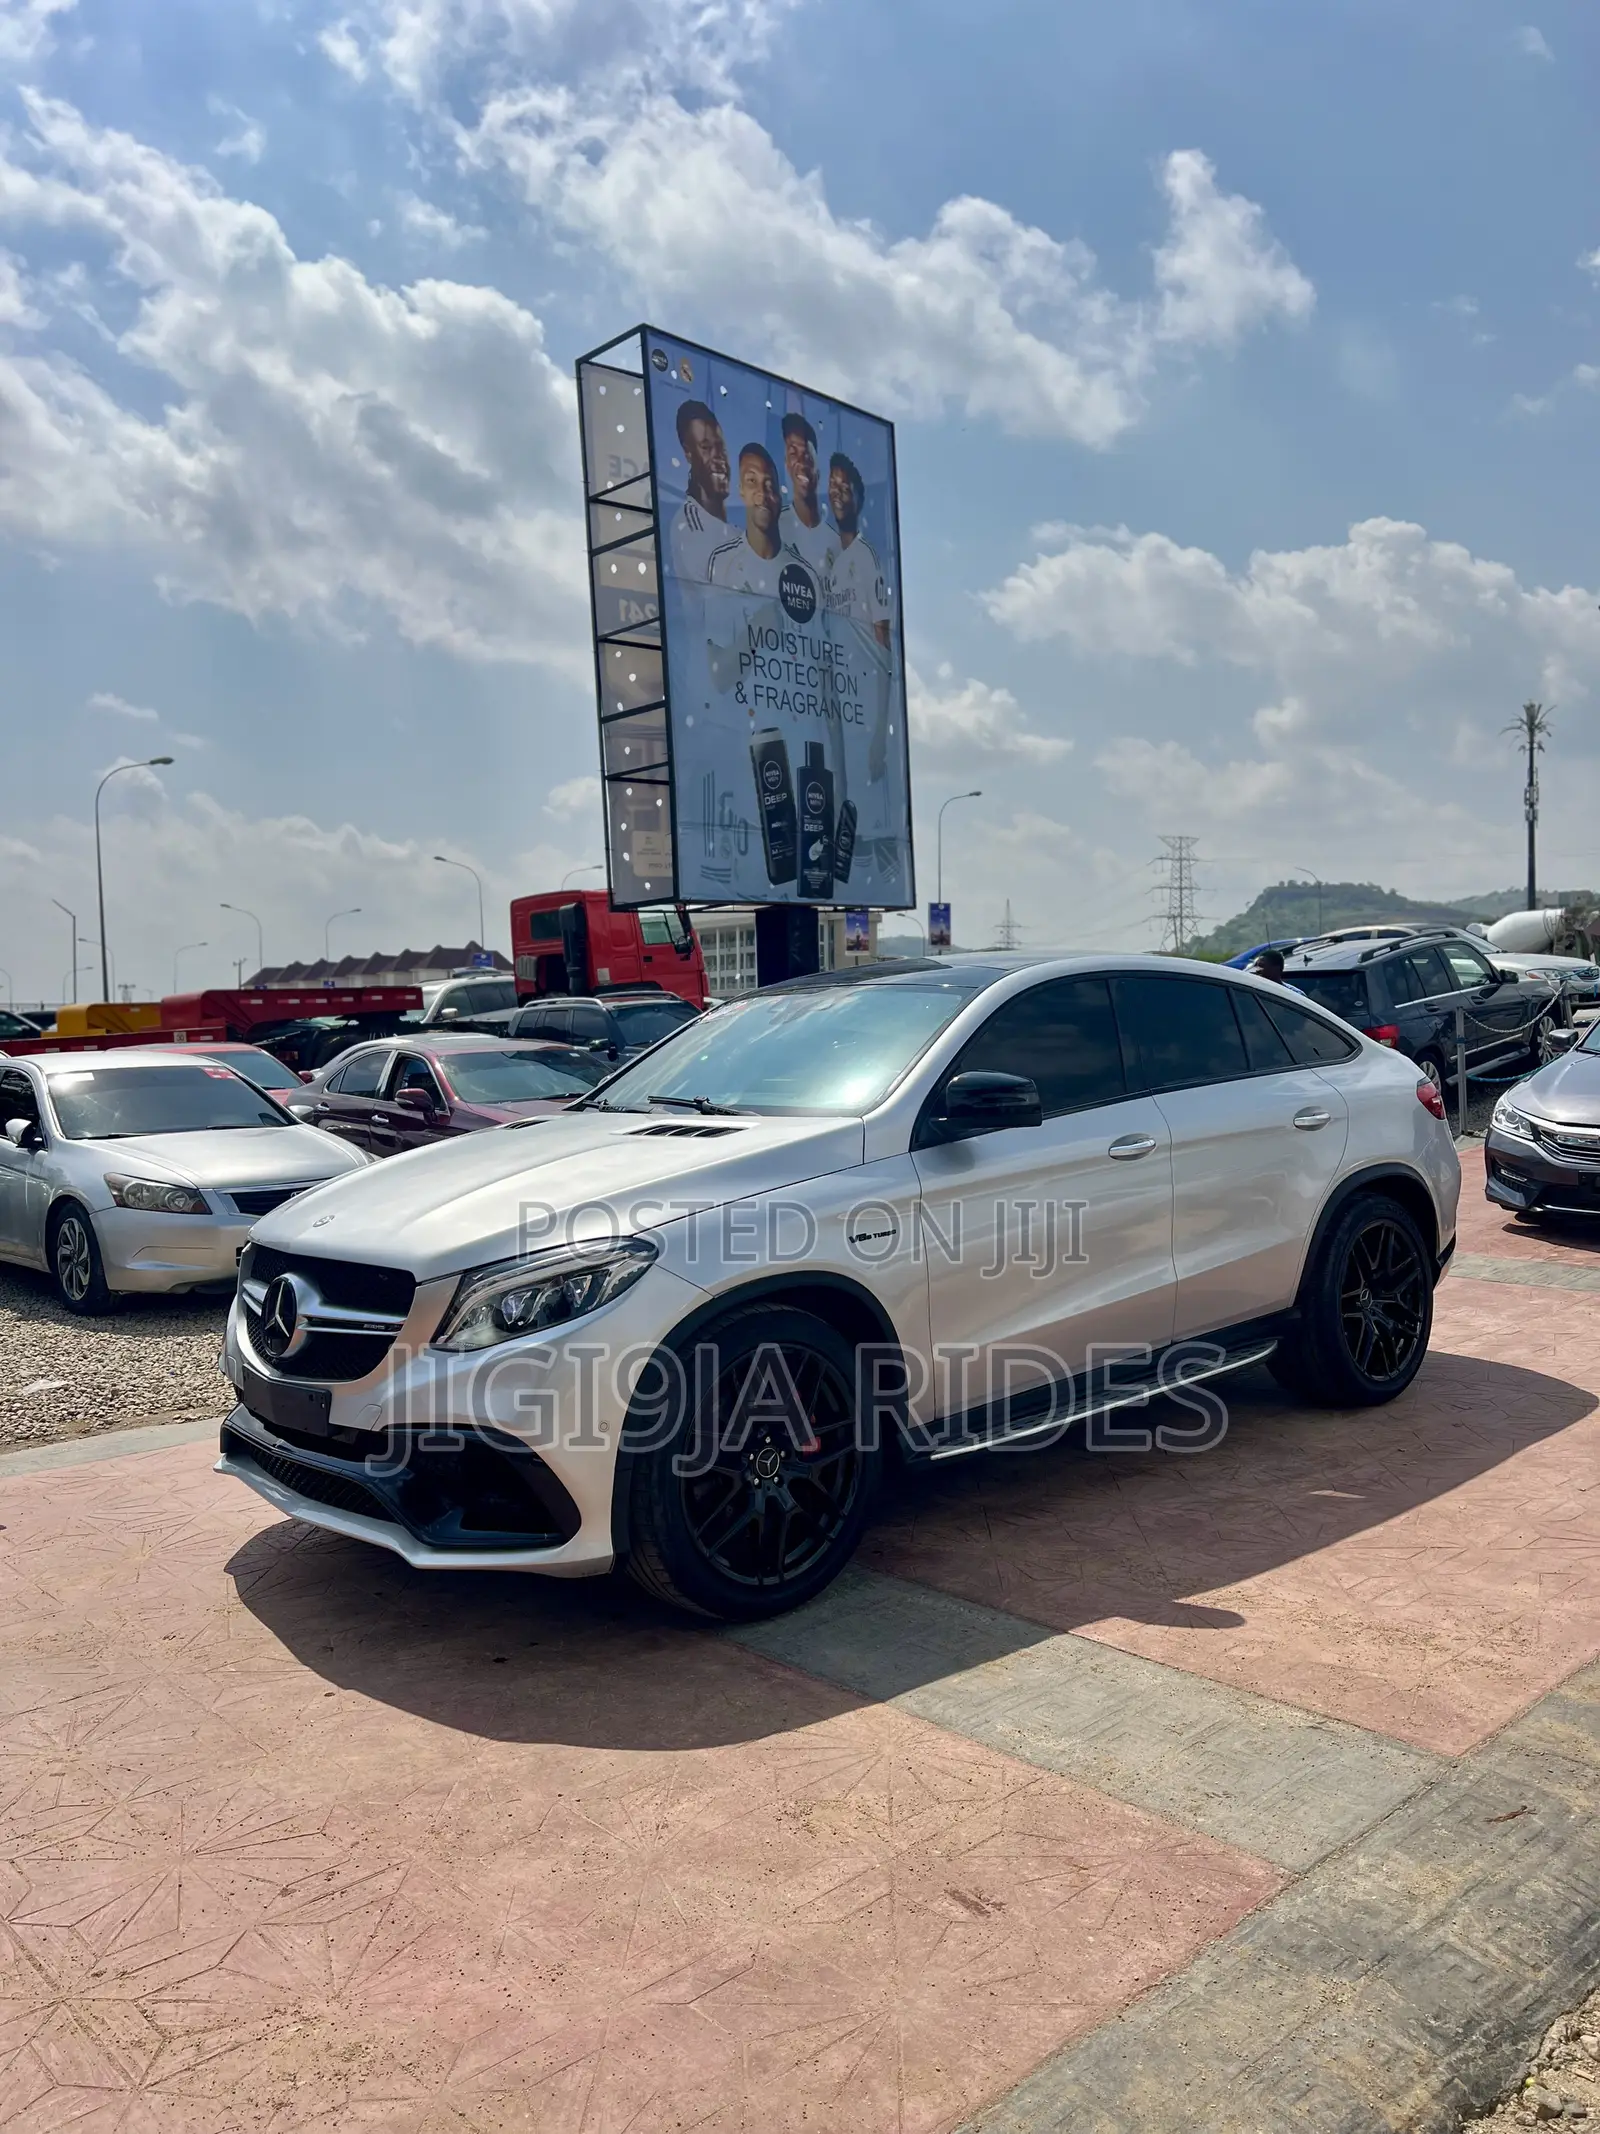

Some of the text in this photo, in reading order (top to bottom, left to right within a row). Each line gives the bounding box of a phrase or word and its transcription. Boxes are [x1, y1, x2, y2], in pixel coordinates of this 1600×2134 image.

[782, 581, 813, 599] NIVEA
[787, 596, 810, 610] MEN
[739, 651, 858, 697] PROTECTION
[735, 681, 865, 726] & FRAGRANCE
[764, 792, 788, 805] DEEP
[804, 823, 824, 832] DEEP
